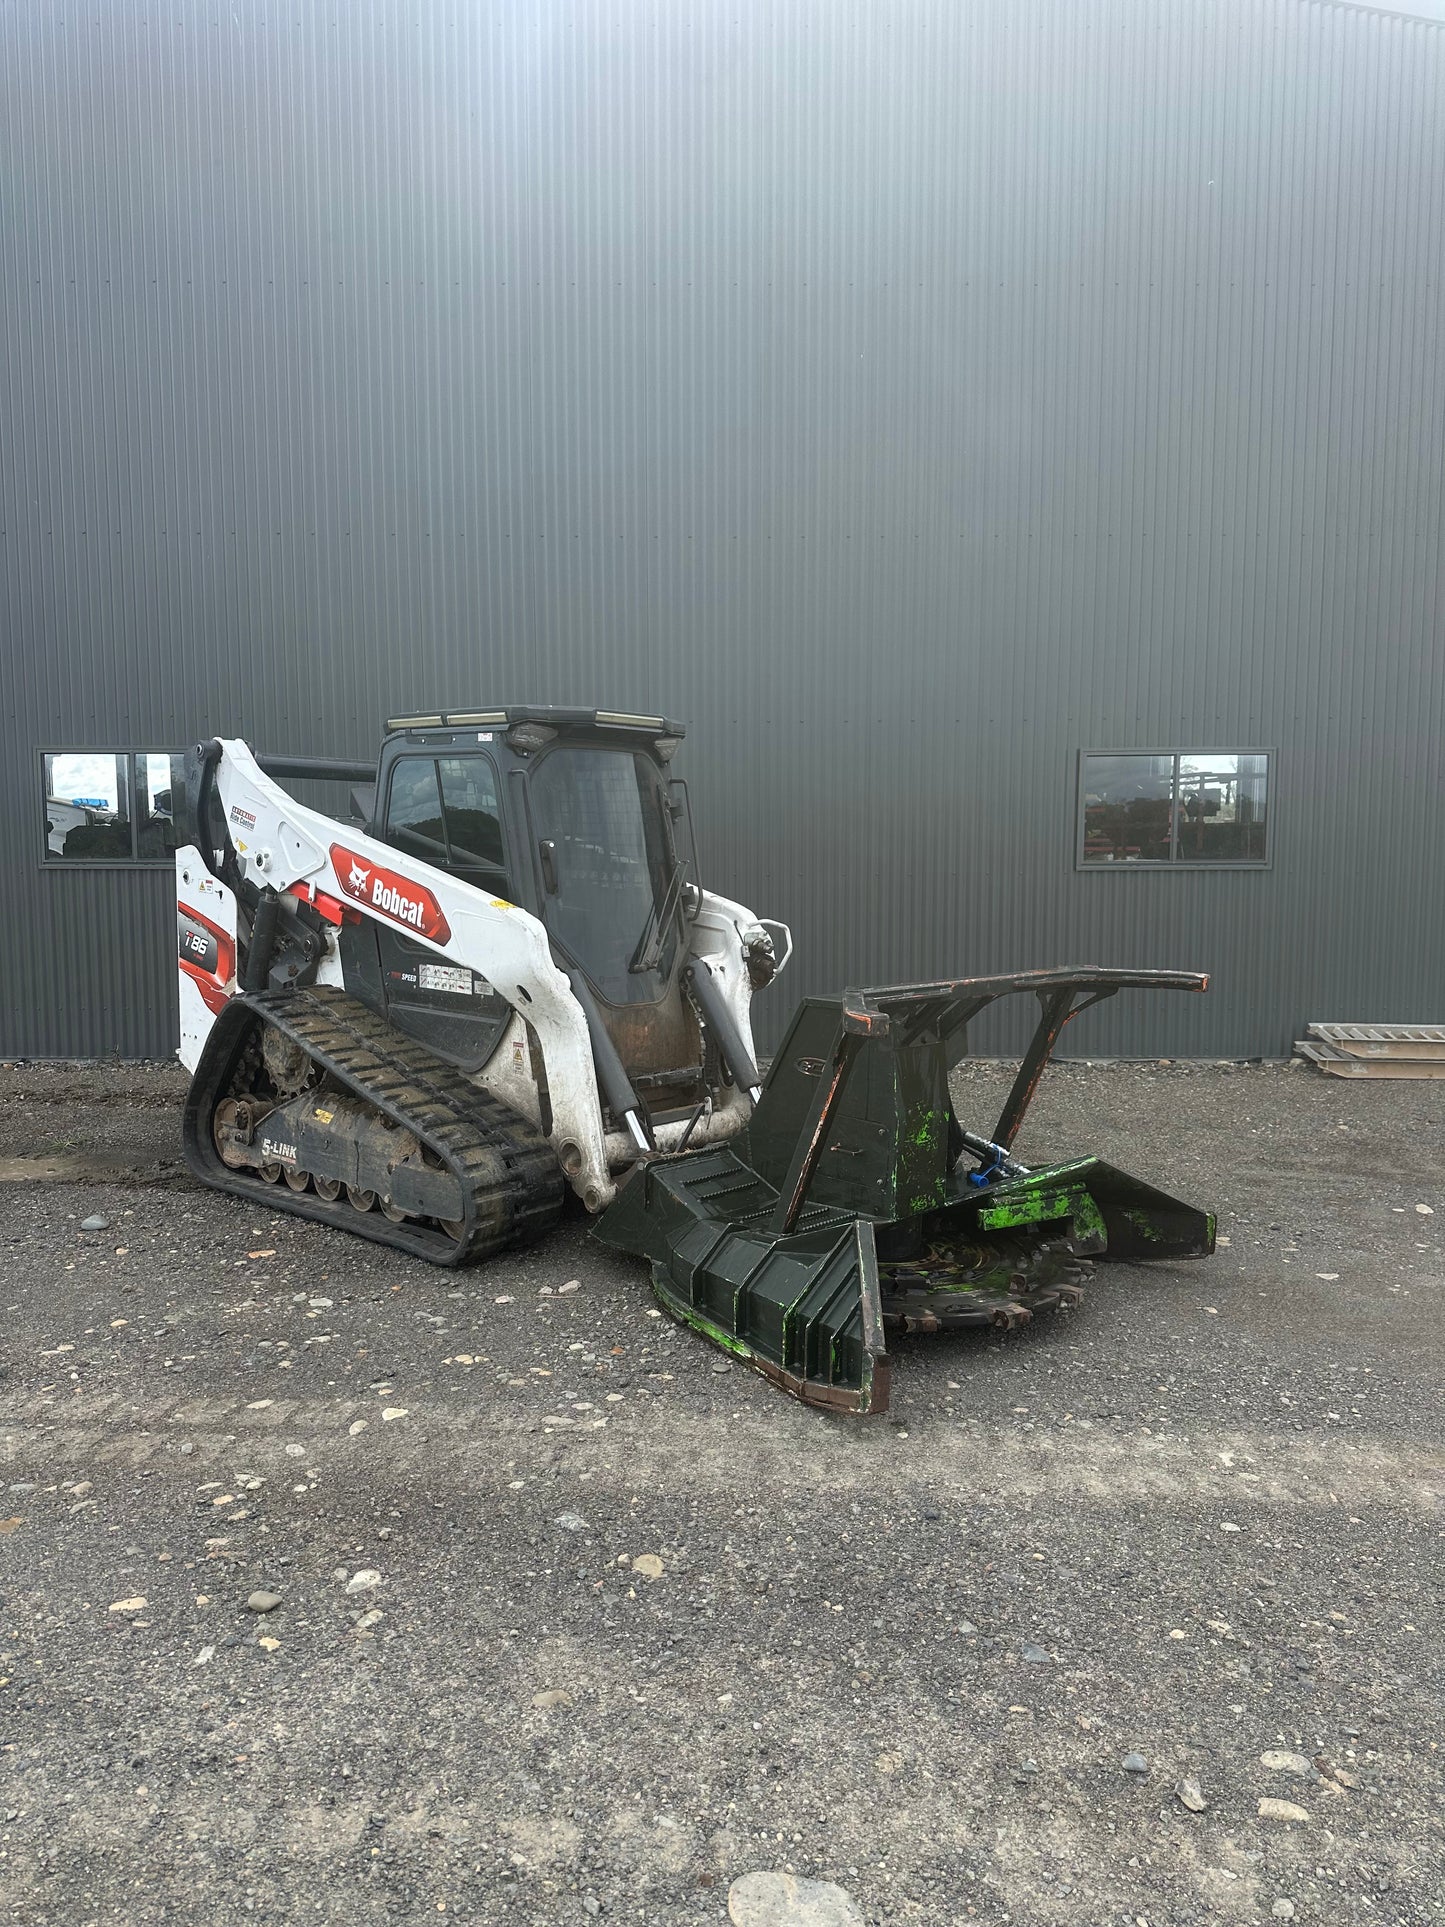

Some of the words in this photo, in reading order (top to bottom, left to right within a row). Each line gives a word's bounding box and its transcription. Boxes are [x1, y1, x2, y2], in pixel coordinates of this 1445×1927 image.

[239, 816, 255, 830] Control
[372, 878, 424, 928] Bobcat
[185, 931, 209, 955] T86
[401, 973, 417, 982] SPEED
[261, 1138, 297, 1159] 5-LINK
